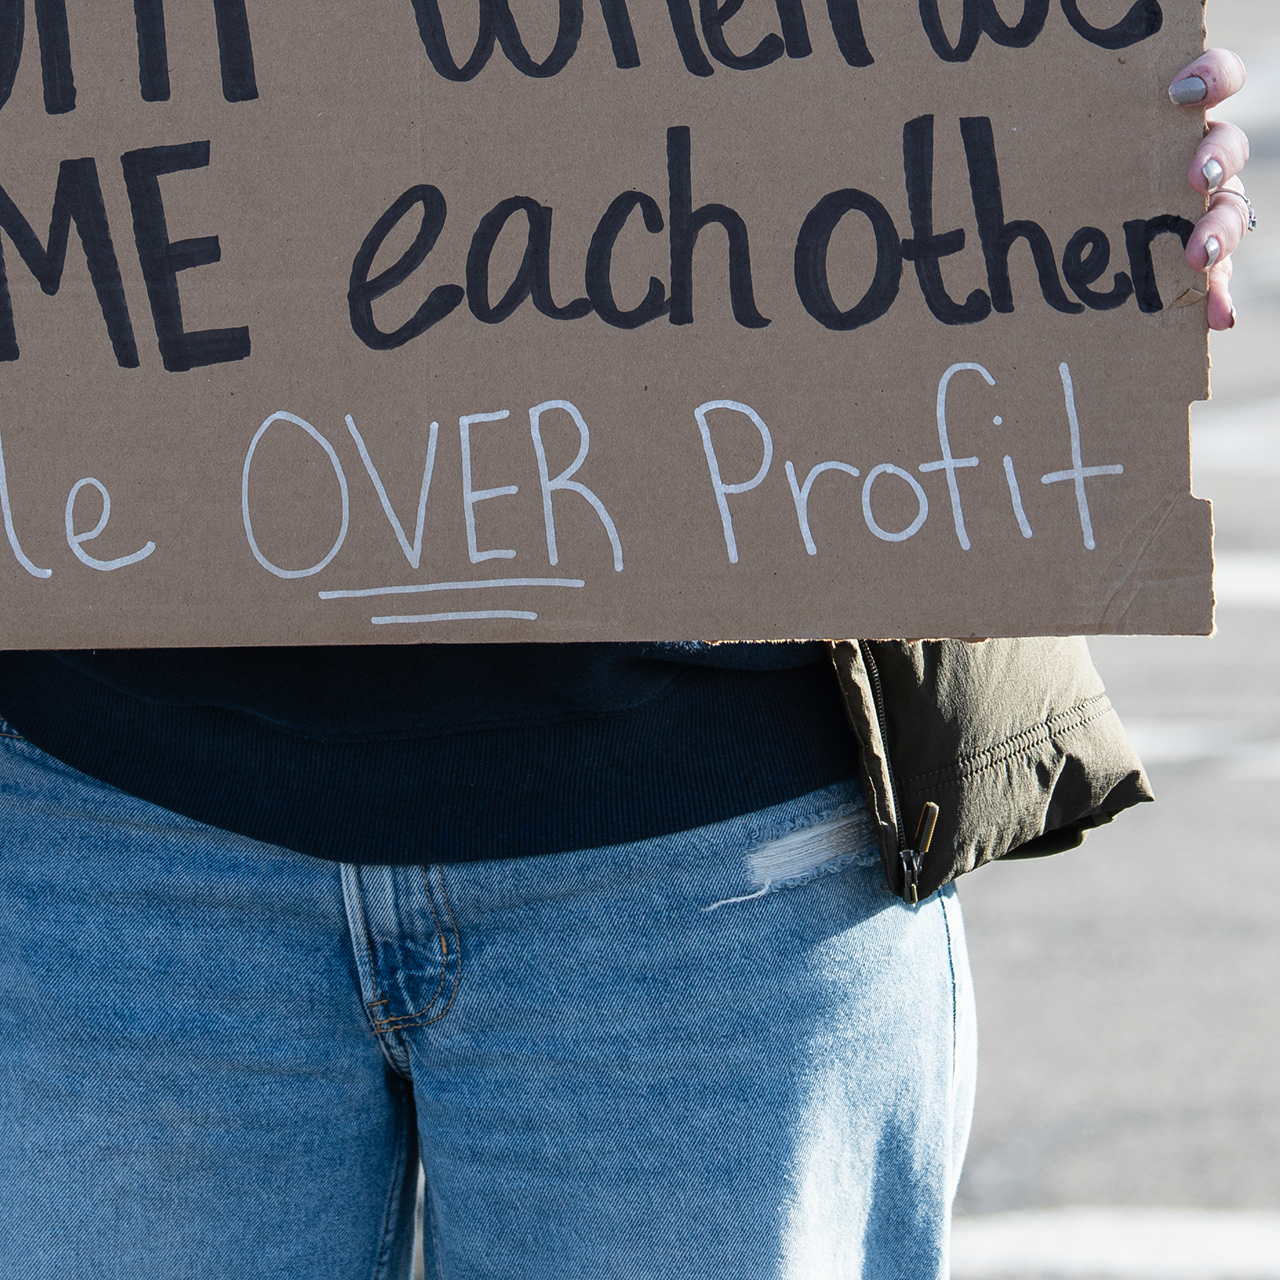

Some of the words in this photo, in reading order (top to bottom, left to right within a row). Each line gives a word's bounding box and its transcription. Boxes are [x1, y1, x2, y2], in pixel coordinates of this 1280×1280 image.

[346, 125, 773, 351] each
[793, 113, 1195, 332] other
[240, 410, 624, 580] OVER
[693, 361, 1125, 566] Profit
